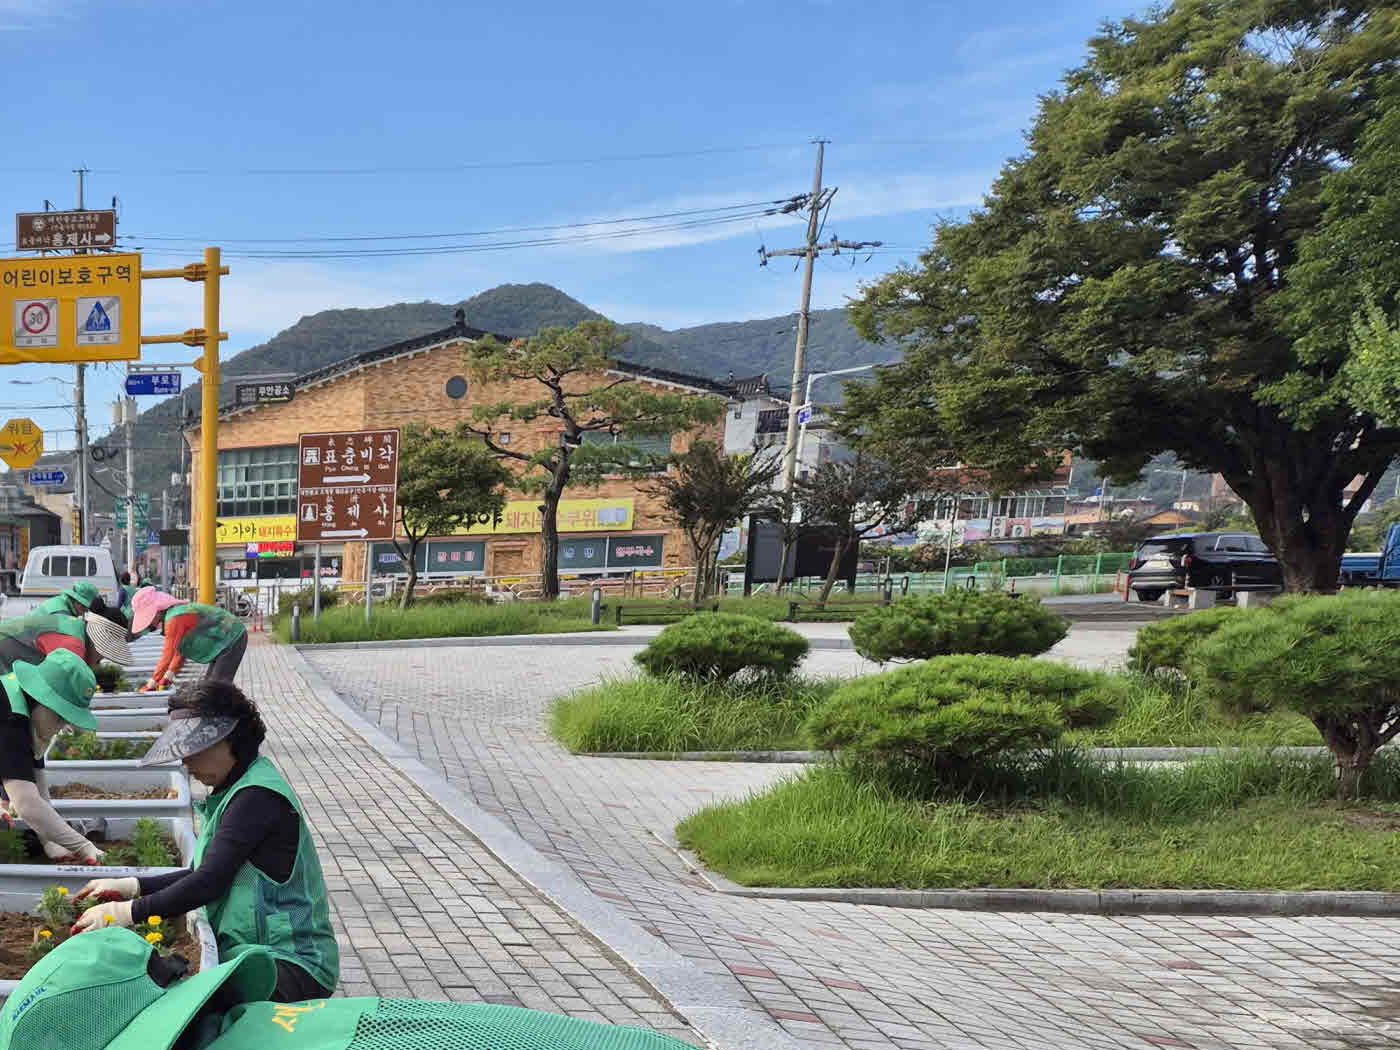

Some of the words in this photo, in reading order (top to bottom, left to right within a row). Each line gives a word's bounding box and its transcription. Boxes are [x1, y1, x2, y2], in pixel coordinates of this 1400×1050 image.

[3, 264, 131, 288] 어린이보호구역
[30, 312, 43, 324] 30
[232, 522, 256, 539] 가야
